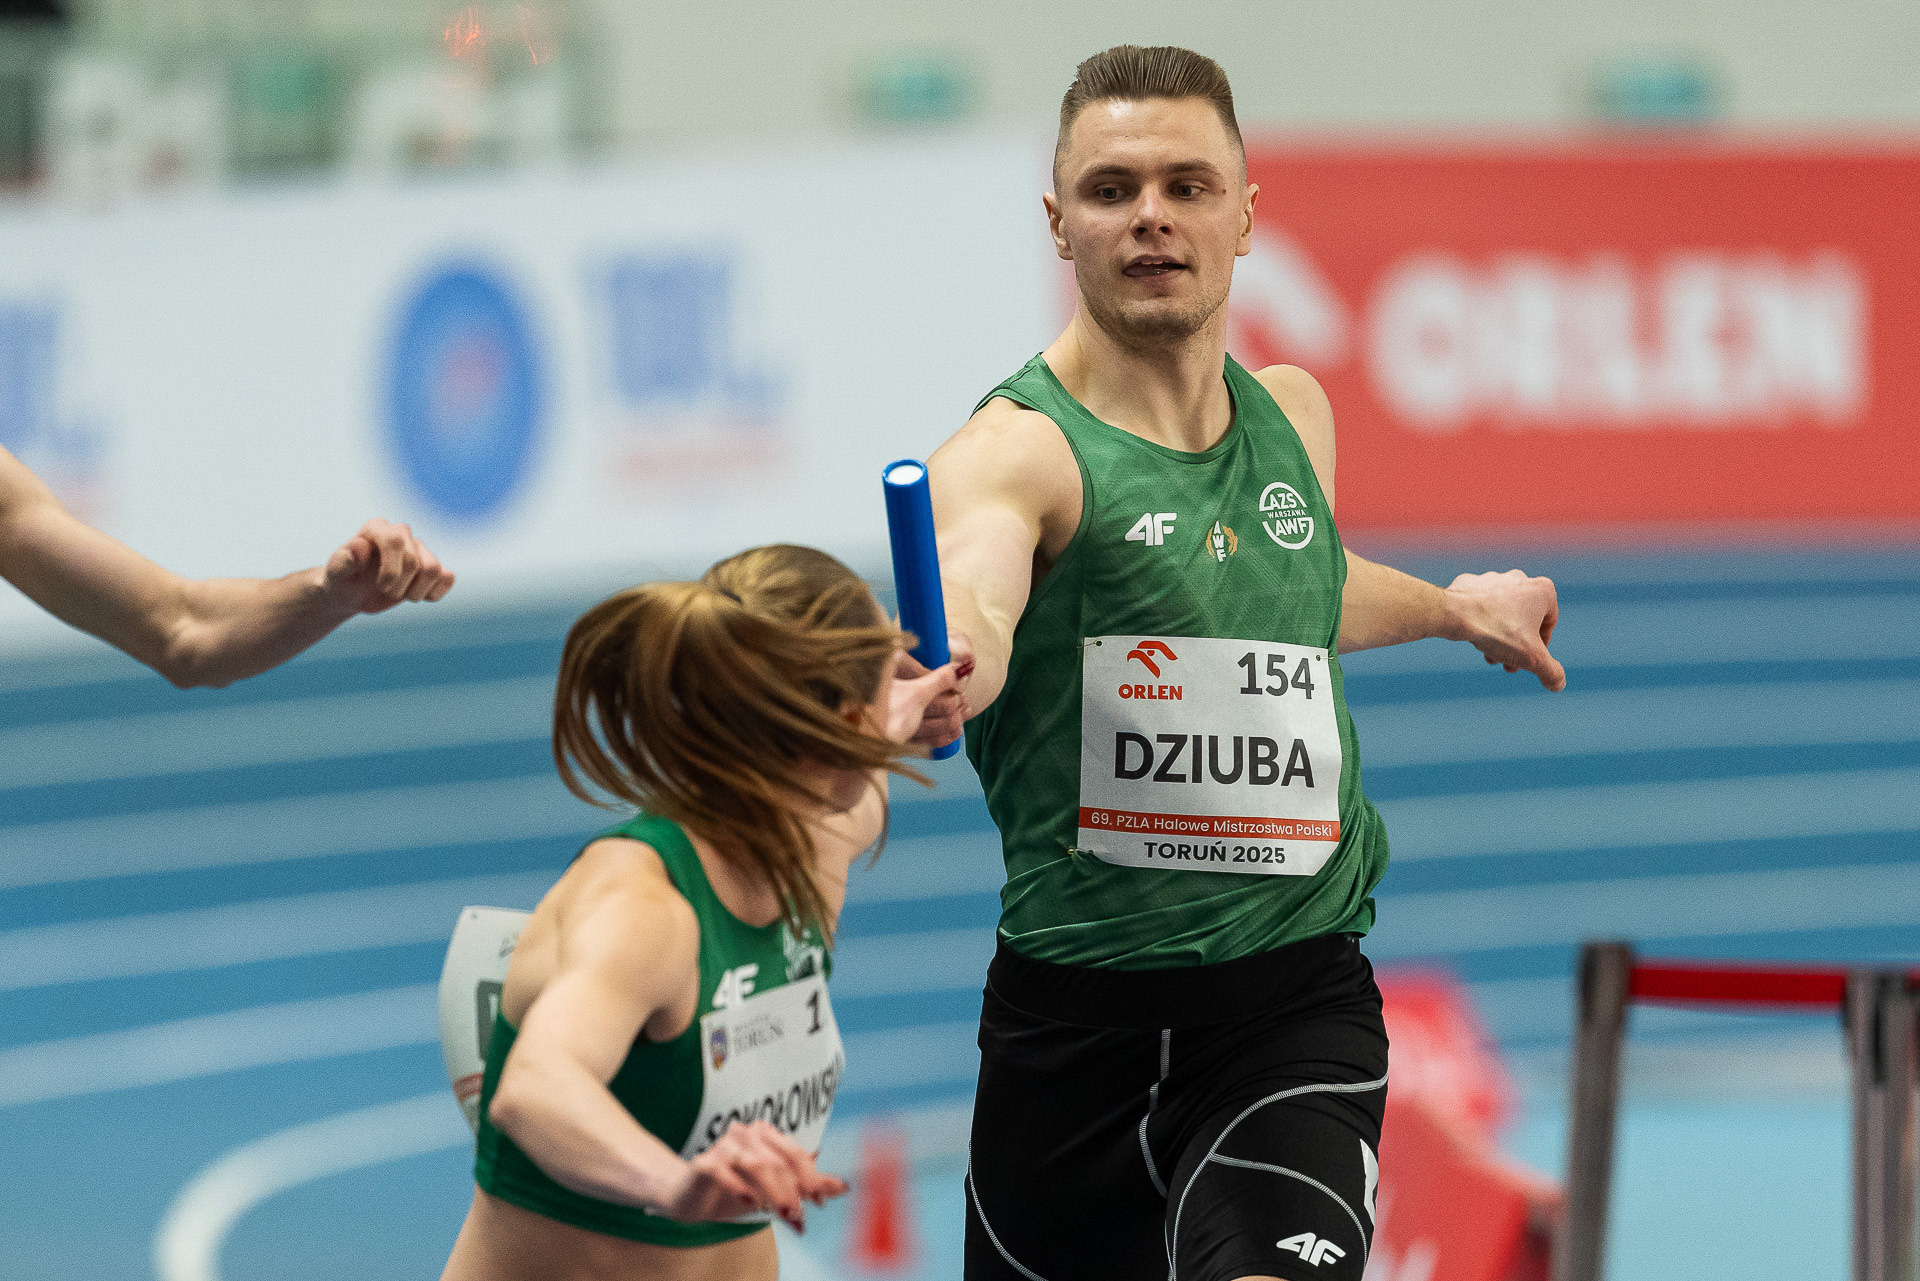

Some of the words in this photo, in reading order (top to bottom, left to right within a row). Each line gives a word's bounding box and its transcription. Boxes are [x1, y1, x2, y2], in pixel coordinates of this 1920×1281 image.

[1268, 493, 1298, 509] AZS
[1267, 509, 1306, 518] WARSZAWA
[1125, 512, 1177, 546] 4F
[1274, 516, 1309, 537] AWF
[1237, 652, 1315, 699] 154
[1118, 683, 1183, 701] ORLEN
[1114, 731, 1315, 788] DZIUBA
[1091, 812, 1113, 826] 69.
[1116, 815, 1150, 829] PZLA
[1154, 818, 1210, 832] Halowe
[1213, 820, 1293, 835] Mistrzostwa
[1296, 824, 1333, 836] Polski
[1144, 840, 1227, 862] TORUŃ
[1232, 845, 1286, 864] 2025
[712, 962, 760, 1010] 4F
[1276, 1232, 1347, 1267] 4F
